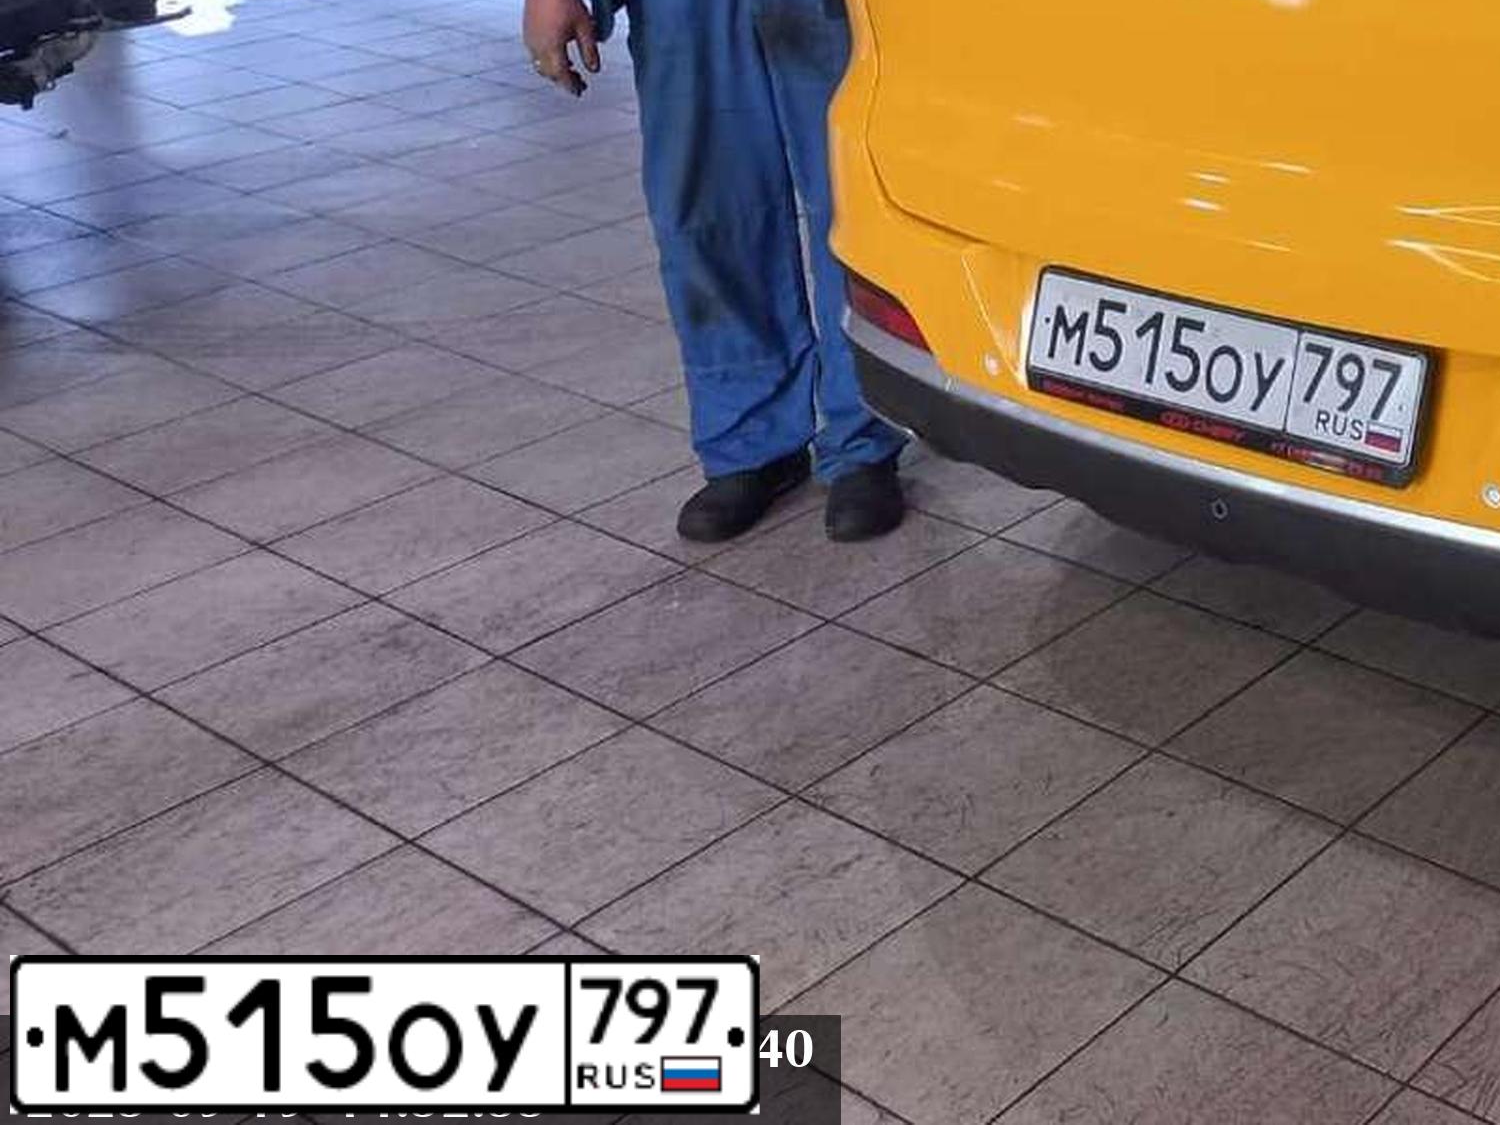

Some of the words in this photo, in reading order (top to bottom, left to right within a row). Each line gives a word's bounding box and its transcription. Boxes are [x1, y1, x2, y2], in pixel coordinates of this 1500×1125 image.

[1047, 299, 1285, 412] М515ОУ
[1303, 342, 1402, 421] 797
[1315, 409, 1364, 442] RUS
